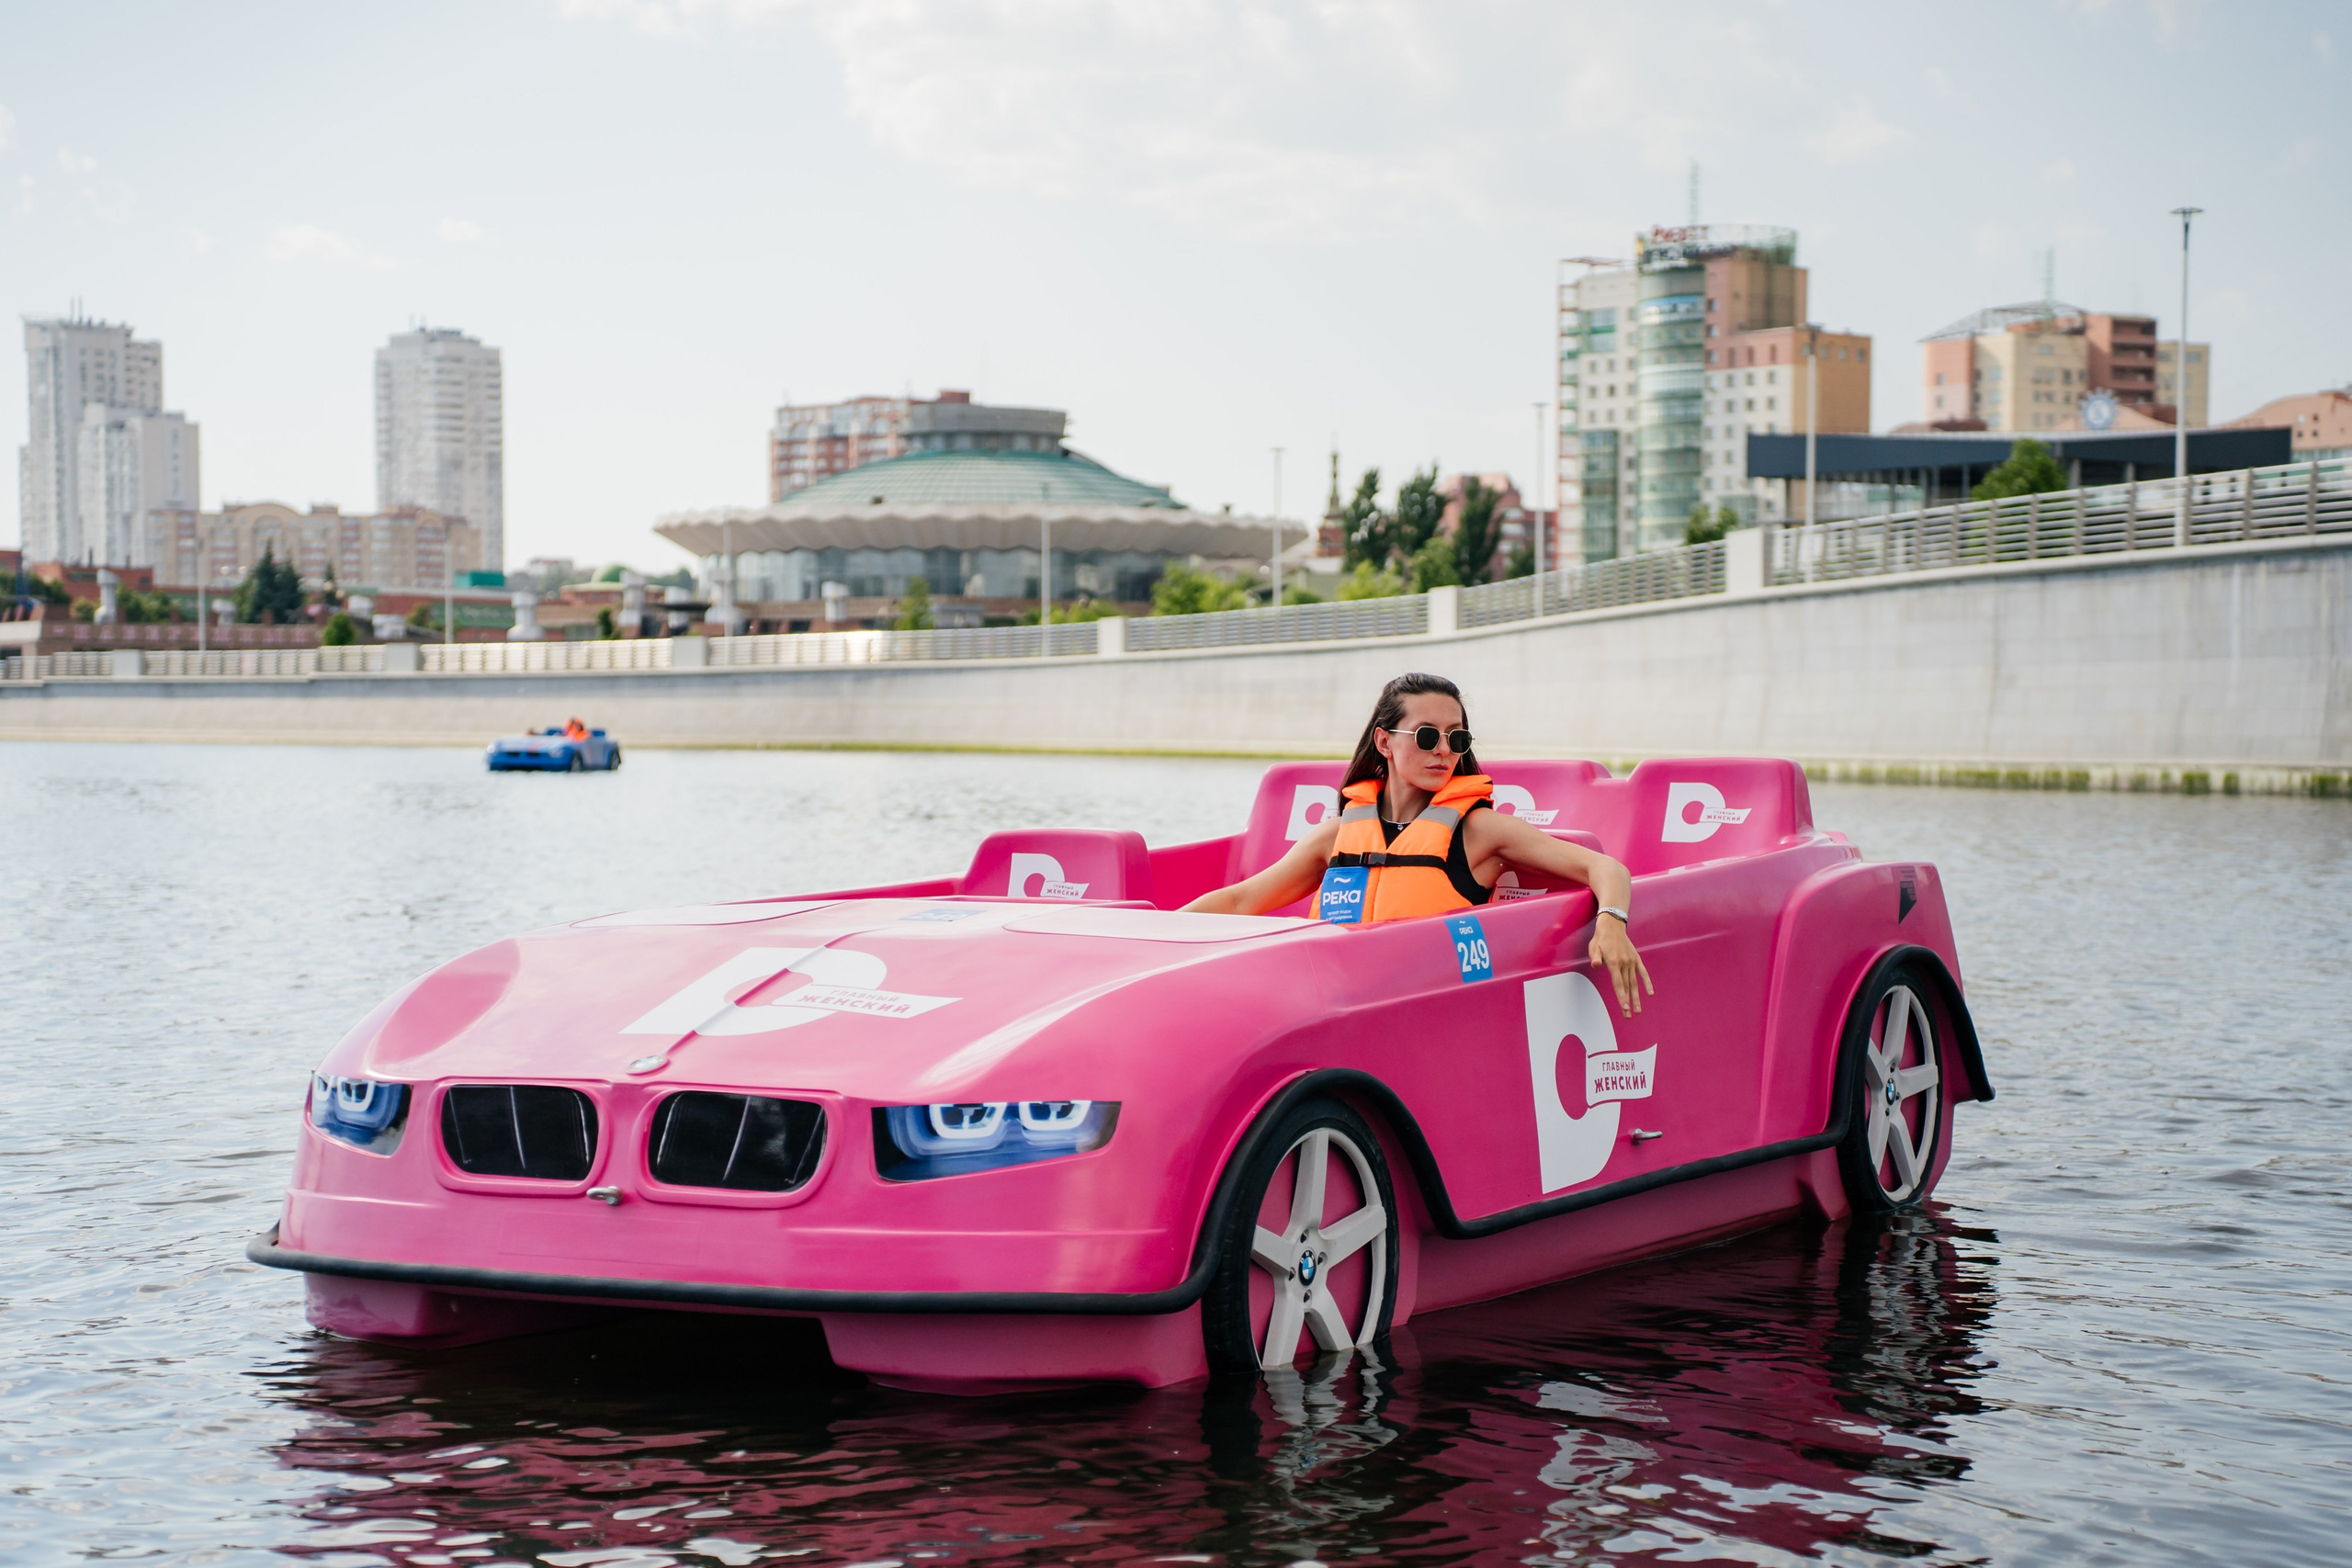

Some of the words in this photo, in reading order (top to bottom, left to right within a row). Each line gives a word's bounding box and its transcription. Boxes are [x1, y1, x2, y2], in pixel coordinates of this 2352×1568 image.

[1046, 888, 1080, 897] ЖЕНСКИЙ
[1457, 939, 1489, 973] 249
[796, 995, 911, 1014] ЖЕНСКИЙ
[829, 989, 899, 1003] ГЛАВНЫЙ
[1601, 1058, 1635, 1073] ГЛАВНЫЙ
[1594, 1071, 1647, 1094] ЖЕНСКИЙ
